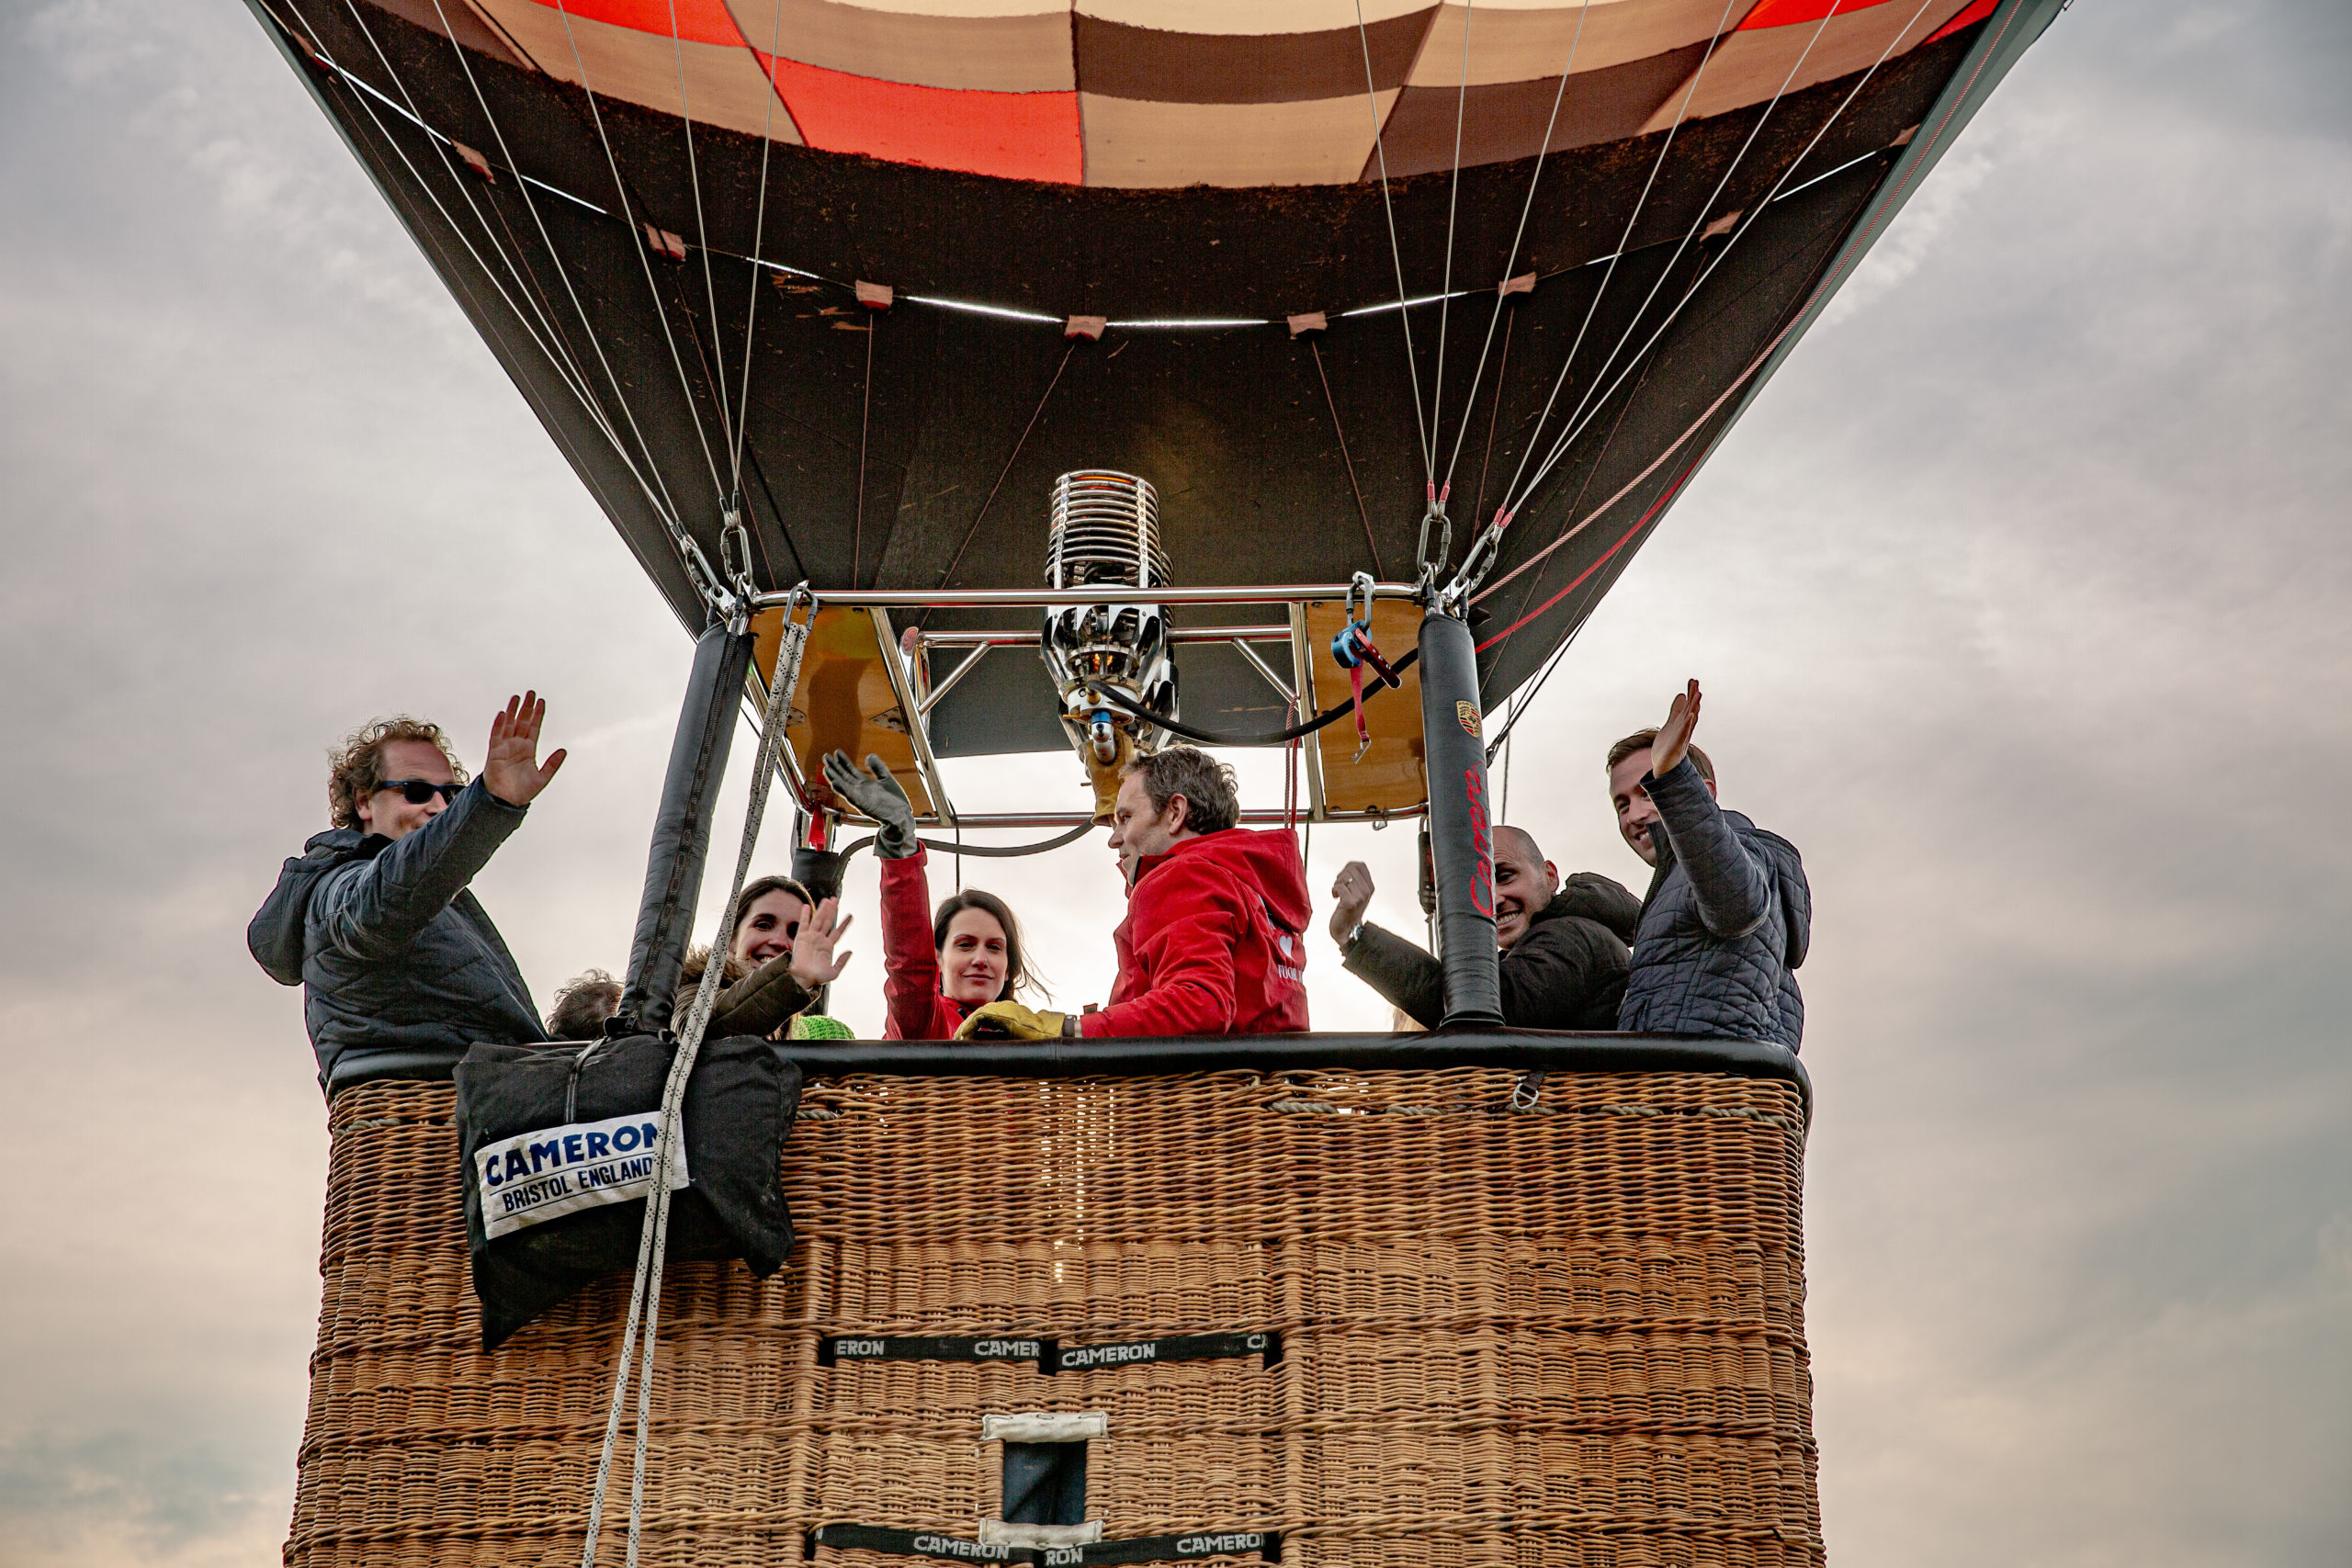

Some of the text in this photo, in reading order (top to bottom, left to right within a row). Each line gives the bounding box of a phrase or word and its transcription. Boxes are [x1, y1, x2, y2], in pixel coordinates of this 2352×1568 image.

[1464, 761, 1495, 918] Carrera
[502, 1156, 652, 1213] BRISTOL ENGLAND
[974, 1340, 1040, 1357] CAMER
[1061, 1343, 1156, 1367] CAMERON
[913, 1535, 1010, 1560] CAMERON
[1045, 1532, 1264, 1566] RON CAMERO
